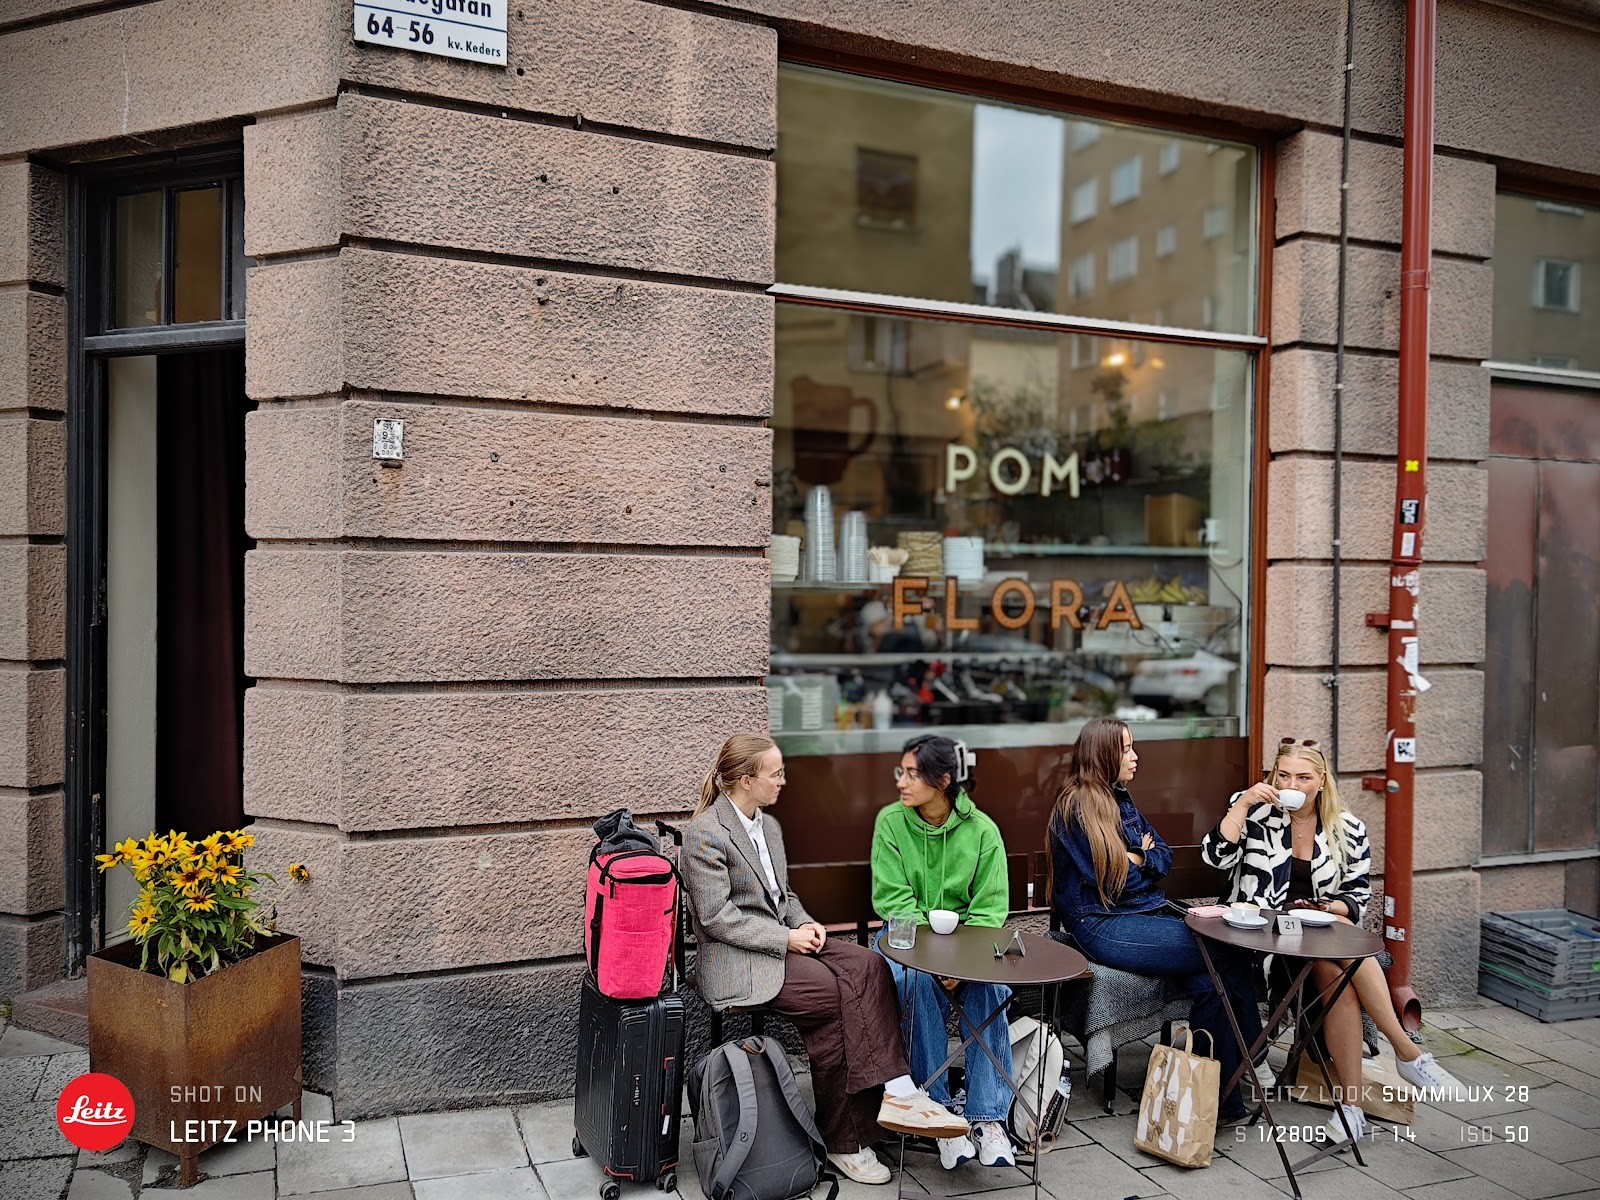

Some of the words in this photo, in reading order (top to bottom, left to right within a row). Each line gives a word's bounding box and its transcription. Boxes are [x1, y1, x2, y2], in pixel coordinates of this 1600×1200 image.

[405, 0, 491, 17] gatan
[447, 36, 463, 51] kv.
[465, 40, 501, 57] Keders
[946, 443, 1080, 498] POM
[892, 575, 1143, 631] FLORA
[1284, 920, 1295, 930] 21
